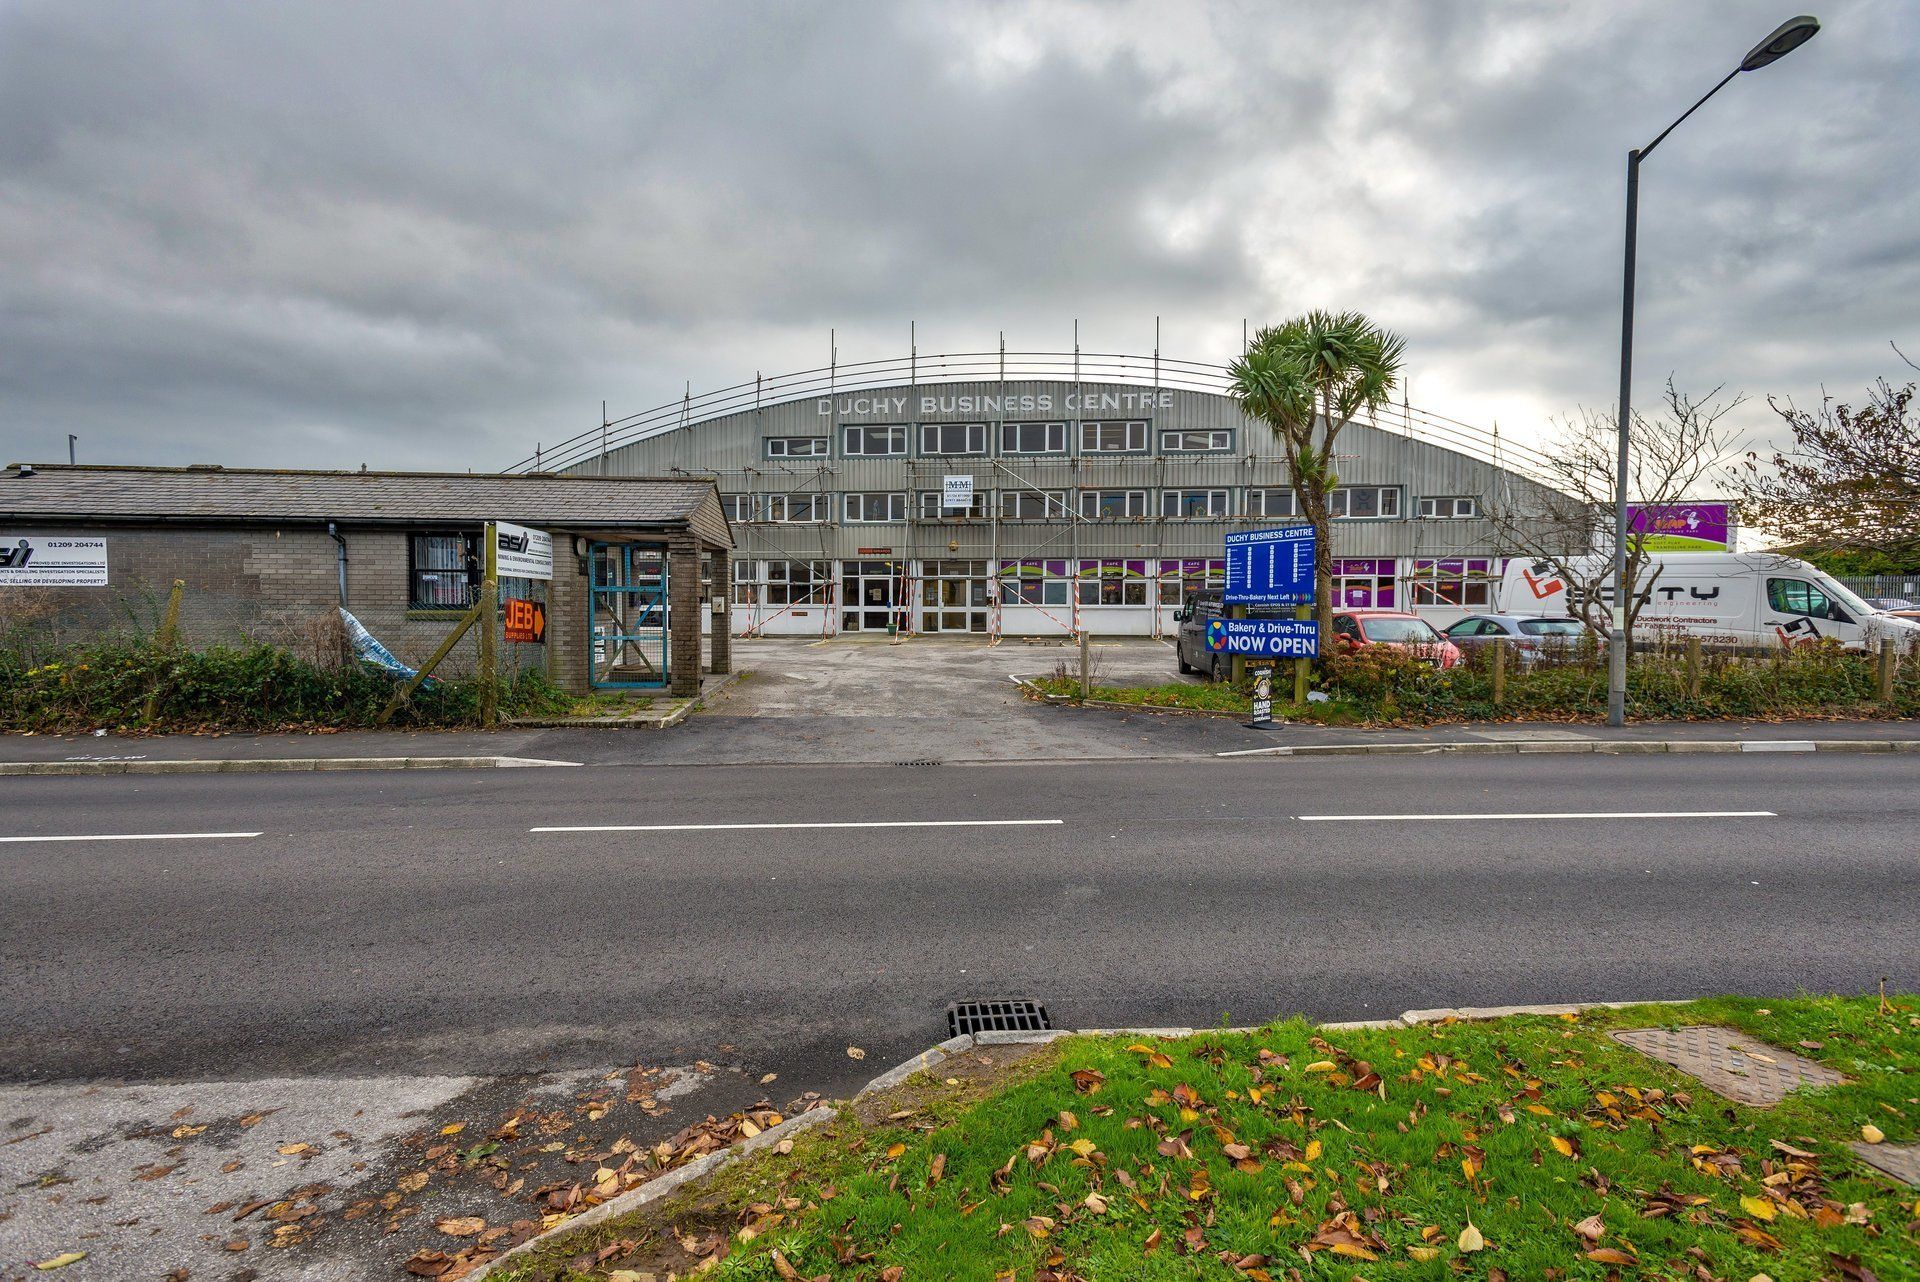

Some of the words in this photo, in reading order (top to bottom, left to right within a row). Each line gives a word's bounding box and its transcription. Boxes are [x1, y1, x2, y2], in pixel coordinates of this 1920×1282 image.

[818, 397, 907, 415] DUCHY
[921, 394, 1052, 413] BUSINESS
[1065, 392, 1174, 410] CENTRE
[1227, 534, 1249, 542] DUCHY
[1250, 531, 1283, 541] BUSINESS
[1285, 528, 1313, 538] CENTRE
[506, 600, 533, 629] JEB
[1228, 622, 1256, 635] Bakery
[1258, 623, 1265, 633] &
[1268, 624, 1315, 634] Drive-Thru
[1228, 636, 1266, 651] NOW
[1270, 637, 1315, 654] OPEN
[1254, 701, 1270, 710] HAND
